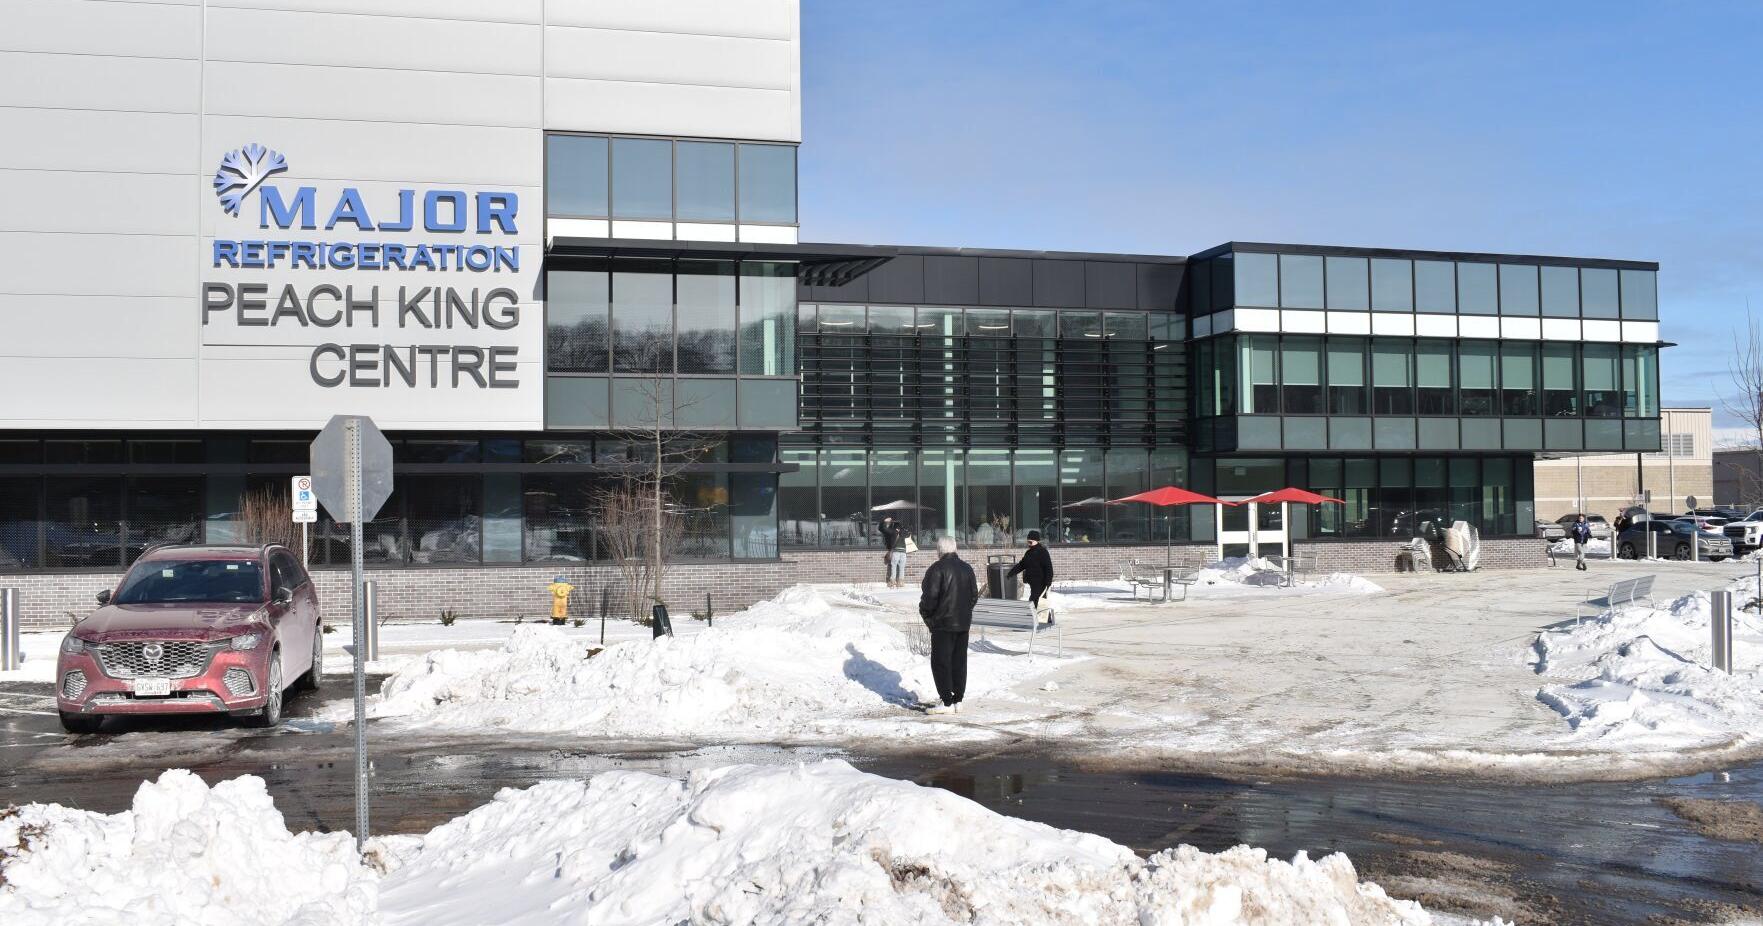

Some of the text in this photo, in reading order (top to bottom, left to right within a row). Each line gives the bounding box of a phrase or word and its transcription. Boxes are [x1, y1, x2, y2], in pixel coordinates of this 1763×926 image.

[259, 185, 519, 234] MAJOR
[213, 239, 519, 273] REFRIGERATION
[202, 282, 519, 330] PEACH KING
[310, 343, 519, 388] CENTRE
